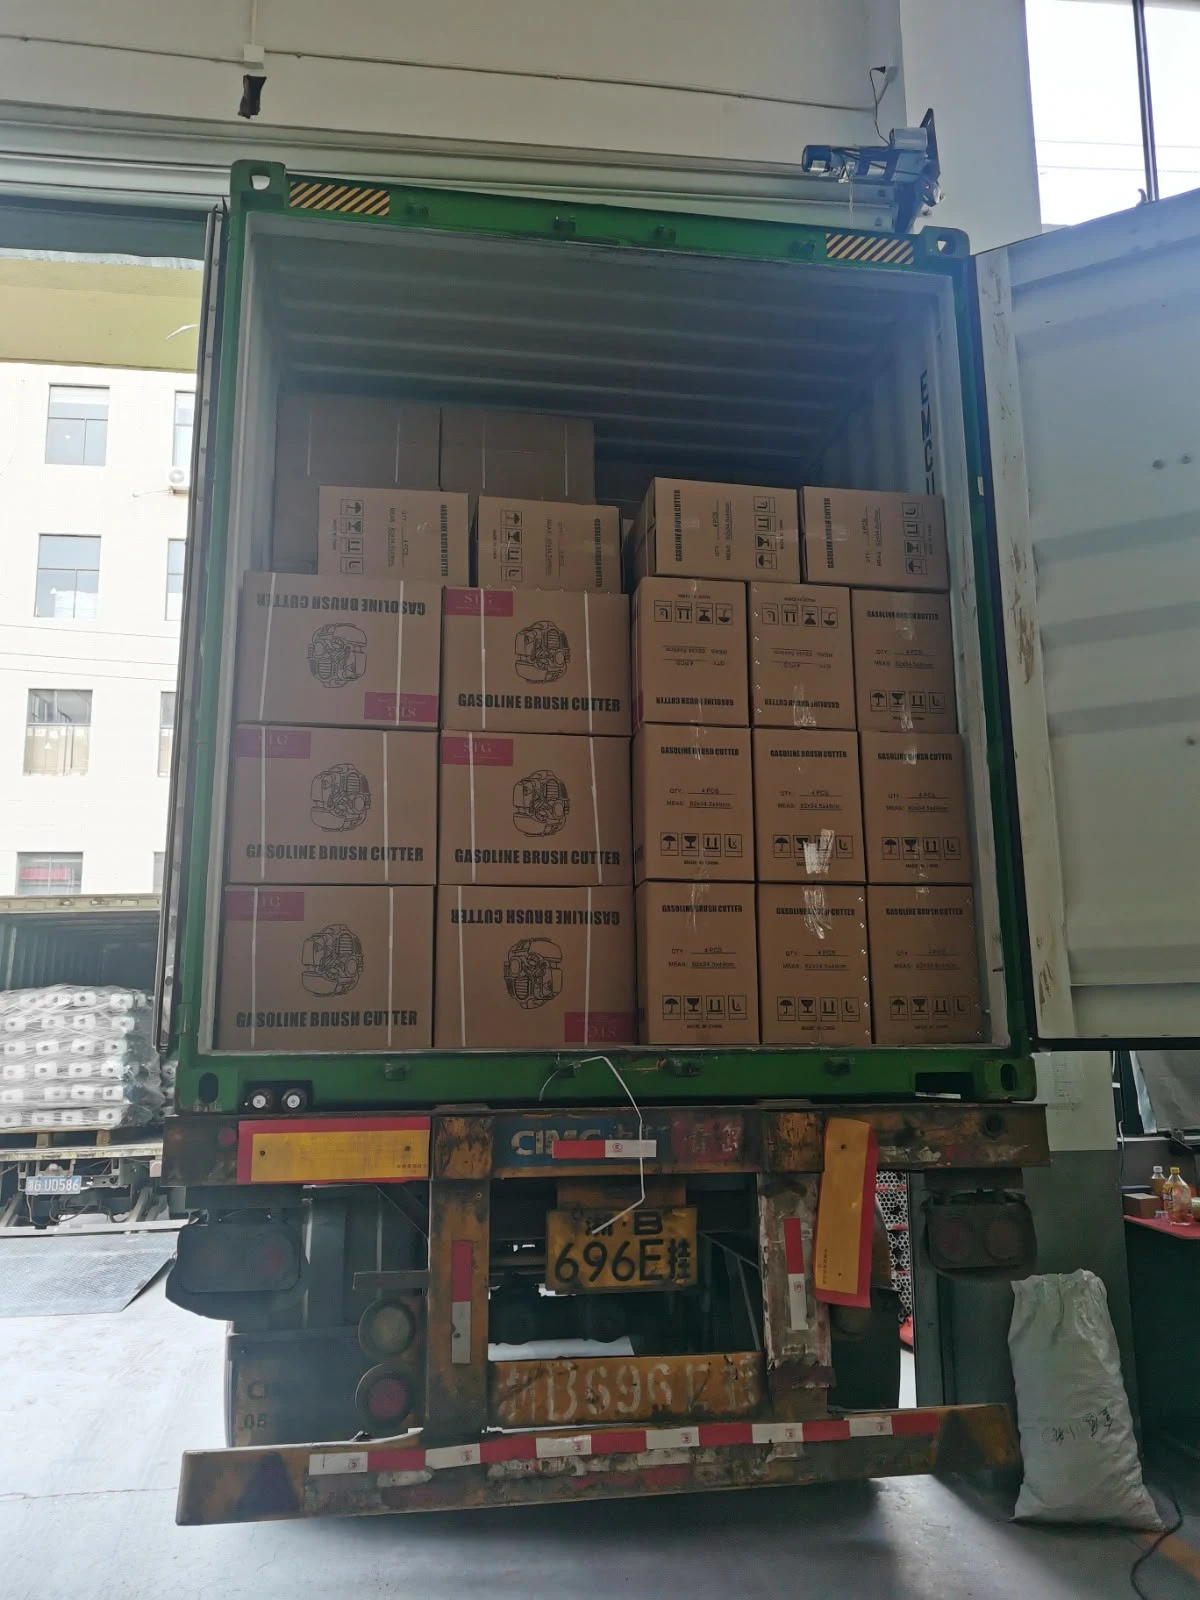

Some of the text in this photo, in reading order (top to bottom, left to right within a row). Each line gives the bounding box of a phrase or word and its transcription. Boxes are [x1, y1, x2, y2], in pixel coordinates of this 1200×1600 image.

[257, 593, 426, 616] GASOLINE BRUSH CUTTER
[458, 693, 620, 712] GASOLINE BRUSH CUTTER
[660, 746, 692, 754] GASOLINE
[715, 748, 740, 756] CUTTER
[246, 843, 424, 862] GASOLINE BRUSH CUTTER
[454, 848, 621, 866] GASOLINE BRUSH CUTTER
[450, 908, 620, 926] GASOLINE BRUSH CUTTER
[718, 905, 742, 913] CUTTER
[236, 1010, 418, 1028] GASOLINE BRUSH CUTTER
